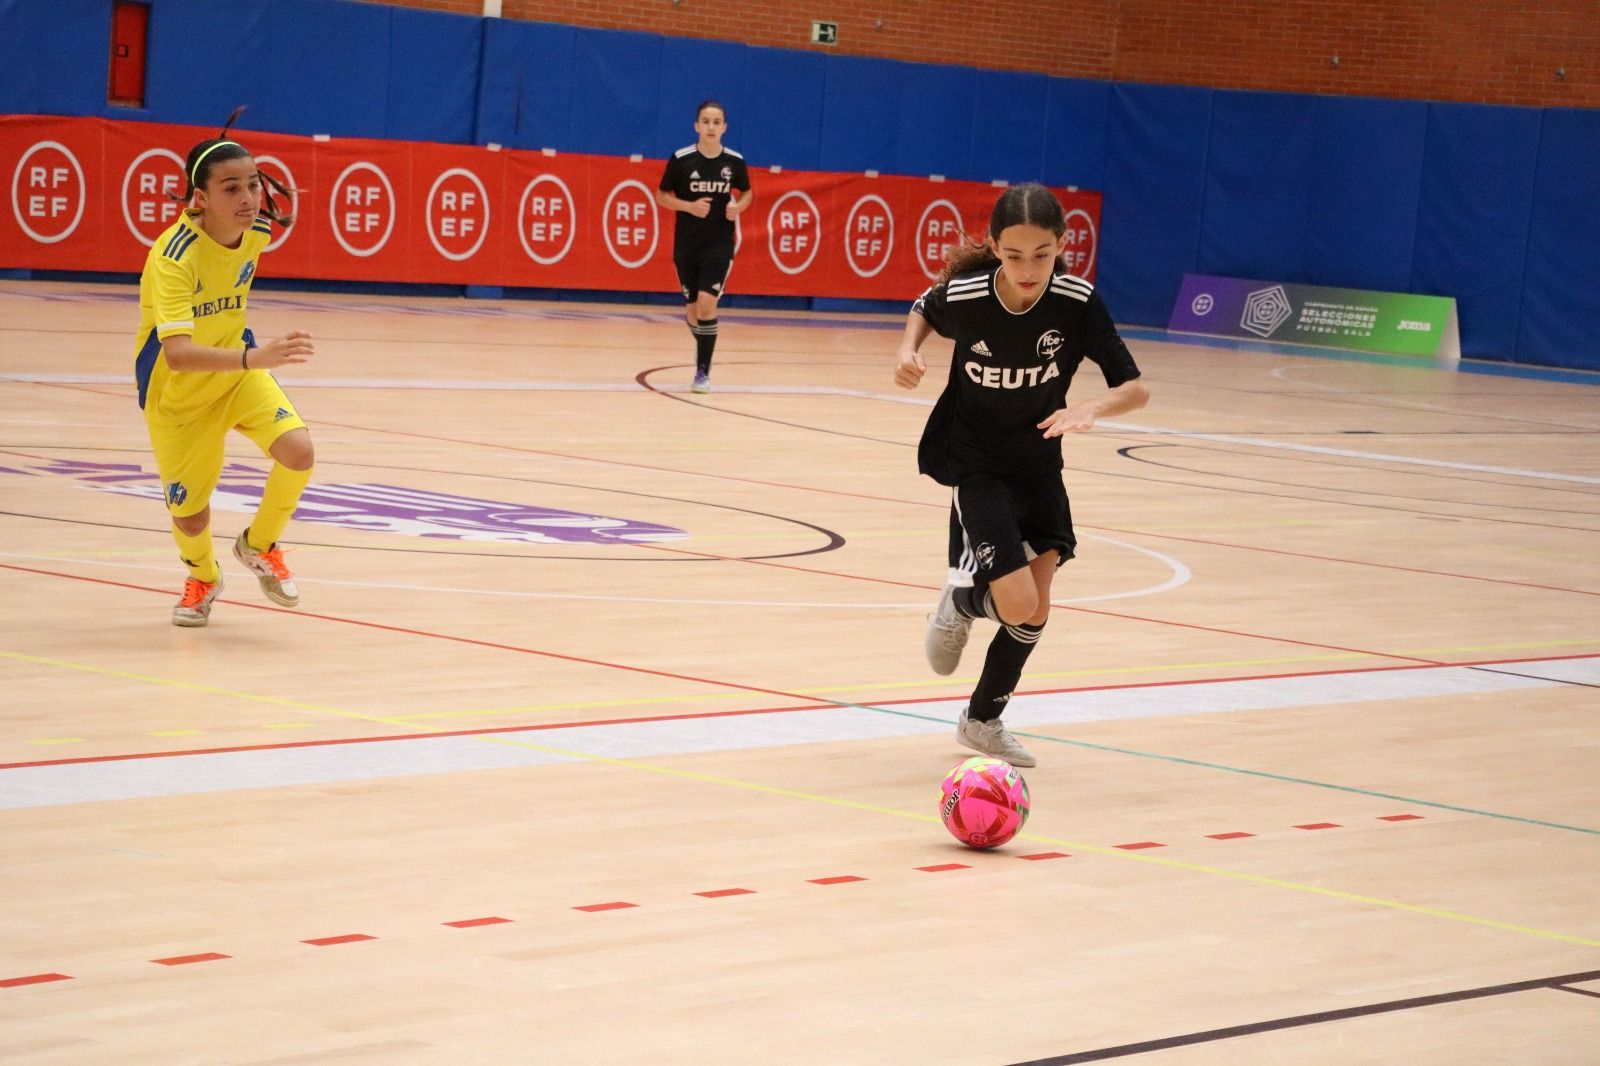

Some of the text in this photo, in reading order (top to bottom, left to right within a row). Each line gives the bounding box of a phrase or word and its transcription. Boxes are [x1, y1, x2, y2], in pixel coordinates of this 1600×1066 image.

[31, 167, 69, 188] RF
[140, 173, 179, 195] RF
[346, 185, 380, 206] RF
[441, 191, 475, 211] RF
[29, 196, 67, 217] EF
[139, 202, 177, 222] EF
[532, 197, 562, 216] RF
[616, 202, 646, 220] RF
[345, 212, 380, 232] EF
[441, 217, 474, 237] EF
[780, 211, 810, 228] RF
[857, 215, 884, 233] RF
[927, 220, 954, 237] RF
[532, 222, 563, 241] EF
[616, 227, 646, 245] EF
[779, 235, 808, 252] EF
[855, 239, 882, 256] EF
[926, 243, 952, 260] EF
[1301, 308, 1377, 322] SELECCIONES
[965, 361, 1061, 390] CEUTA
